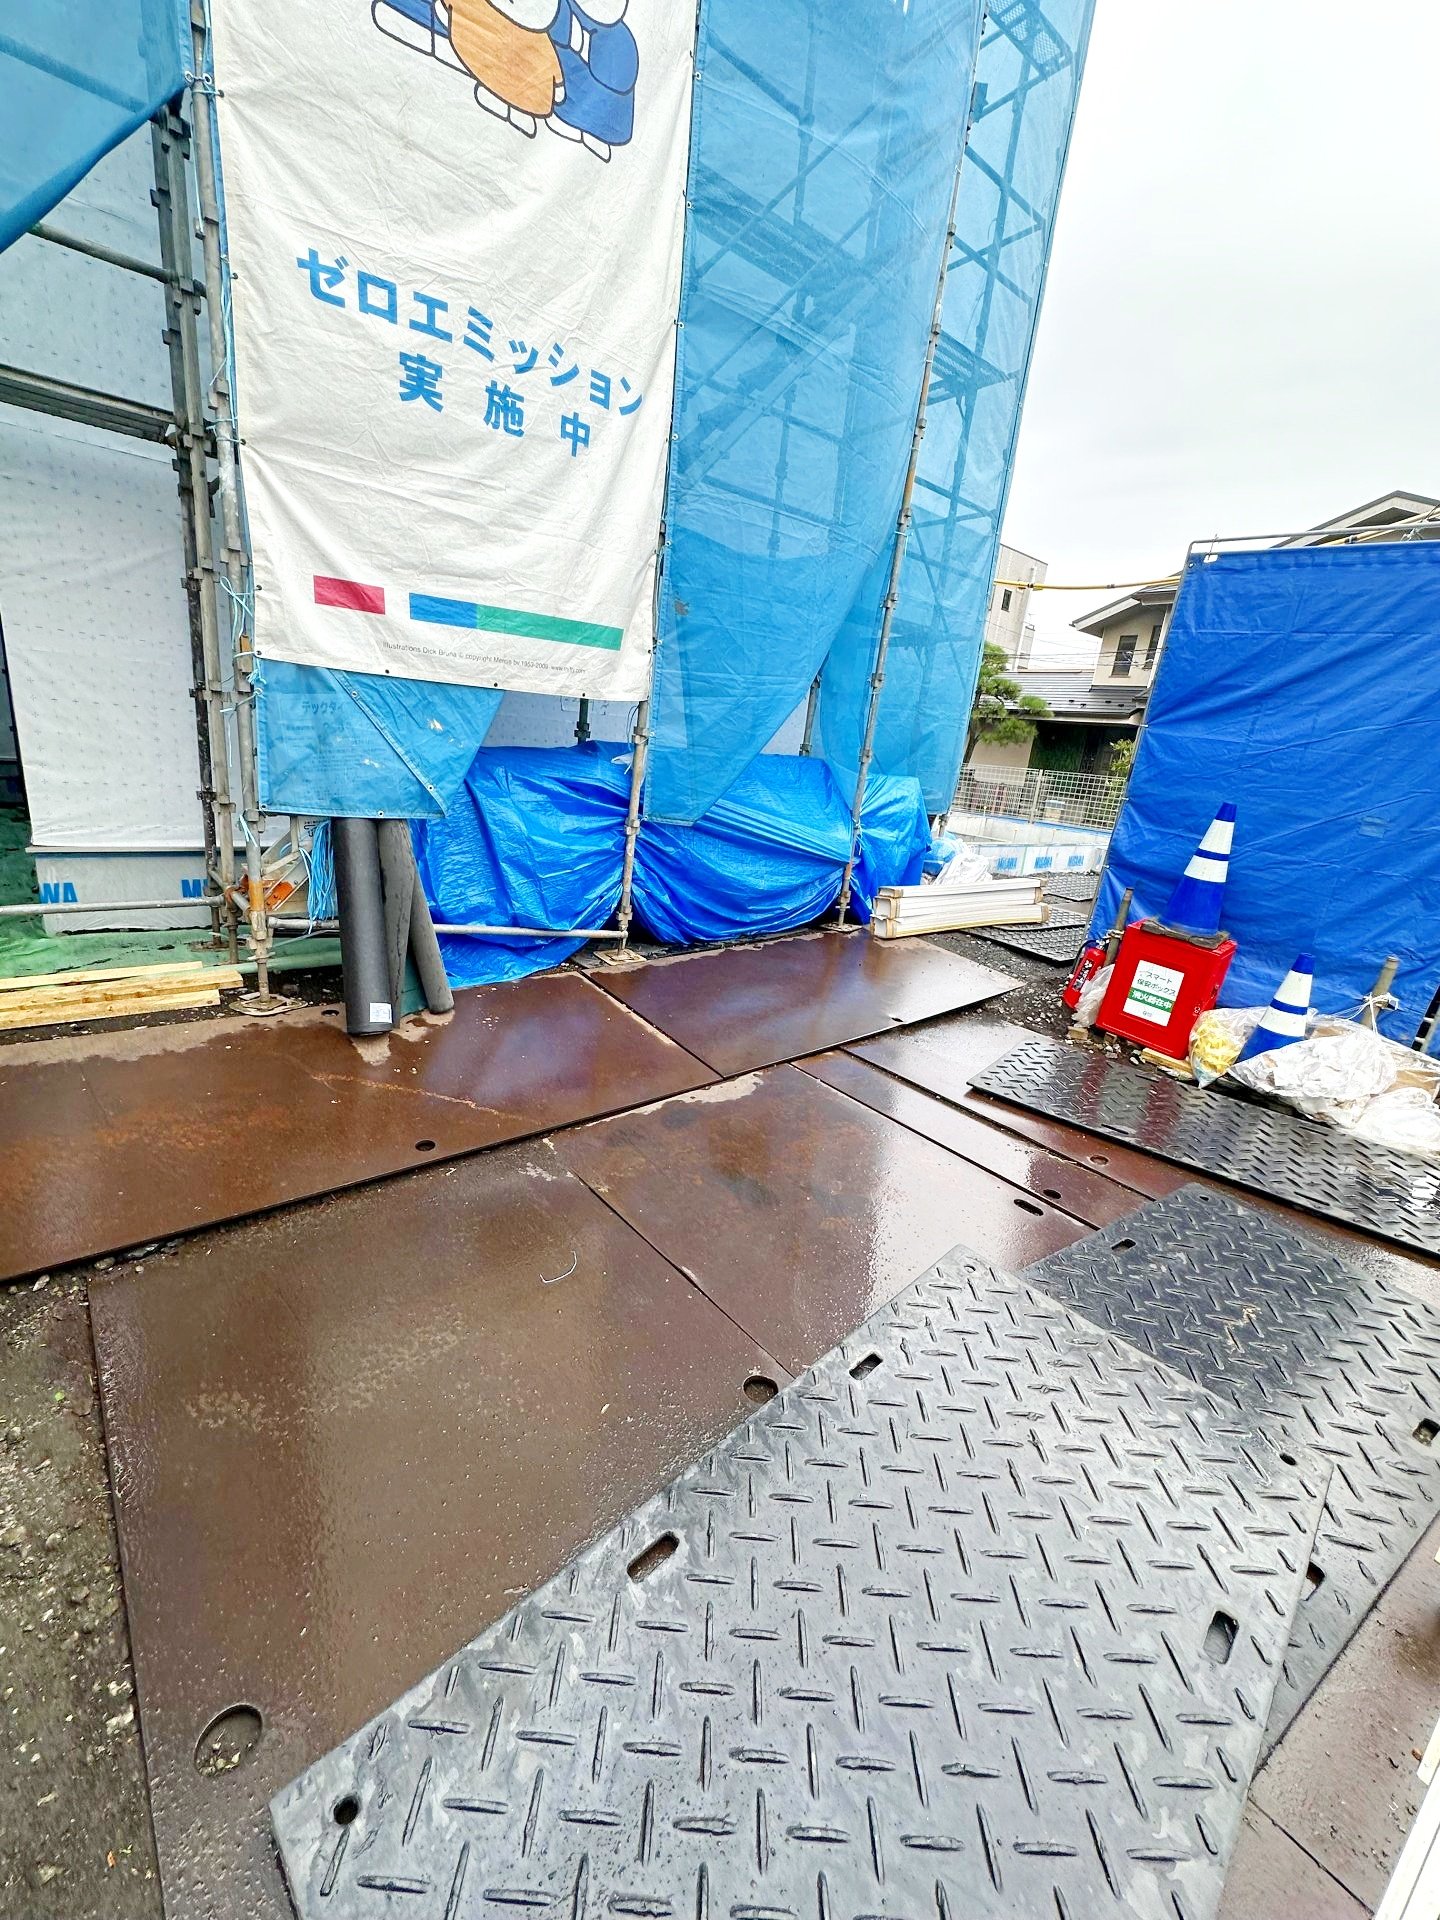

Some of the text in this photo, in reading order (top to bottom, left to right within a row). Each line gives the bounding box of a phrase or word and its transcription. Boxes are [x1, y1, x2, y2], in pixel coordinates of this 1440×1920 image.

[296, 248, 643, 417] ゼロエミッション
[398, 351, 592, 458] 実施中
[382, 641, 421, 653] Illustrations
[422, 646, 437, 655] Dick
[438, 648, 457, 658] Bruna
[1145, 971, 1172, 984] スマート
